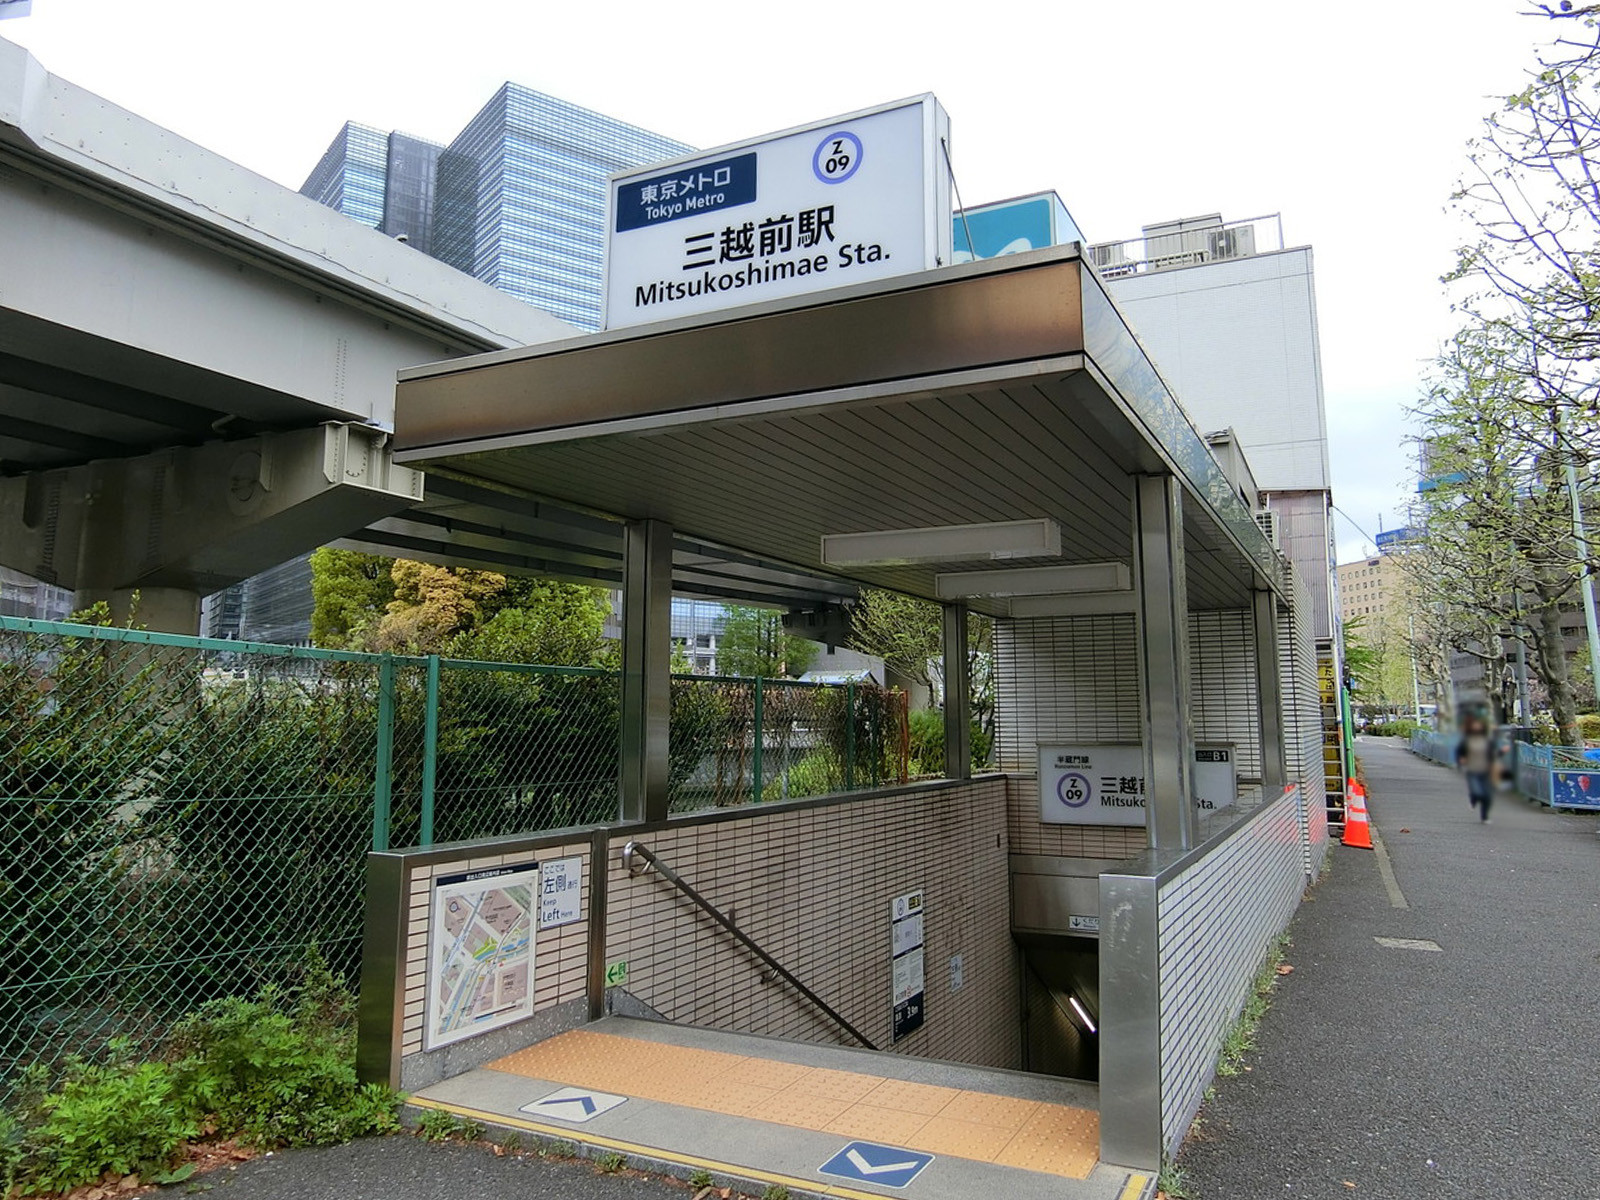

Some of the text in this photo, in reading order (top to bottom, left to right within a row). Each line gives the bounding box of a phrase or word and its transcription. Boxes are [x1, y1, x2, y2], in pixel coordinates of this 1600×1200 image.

[831, 140, 844, 155] Z
[825, 155, 851, 174] 09
[640, 165, 731, 205] 東京メトロ
[645, 191, 726, 220] Tokyo Metro
[682, 204, 836, 271] 三越前駅
[634, 242, 891, 308] Mitsukoshimae Sta.
[1057, 755, 1090, 764] 半蔵門線
[1213, 751, 1227, 761] B1
[1069, 778, 1078, 789] Z
[1100, 776, 1145, 795] 三越
[1065, 789, 1083, 800] 09
[543, 908, 560, 922] Left
